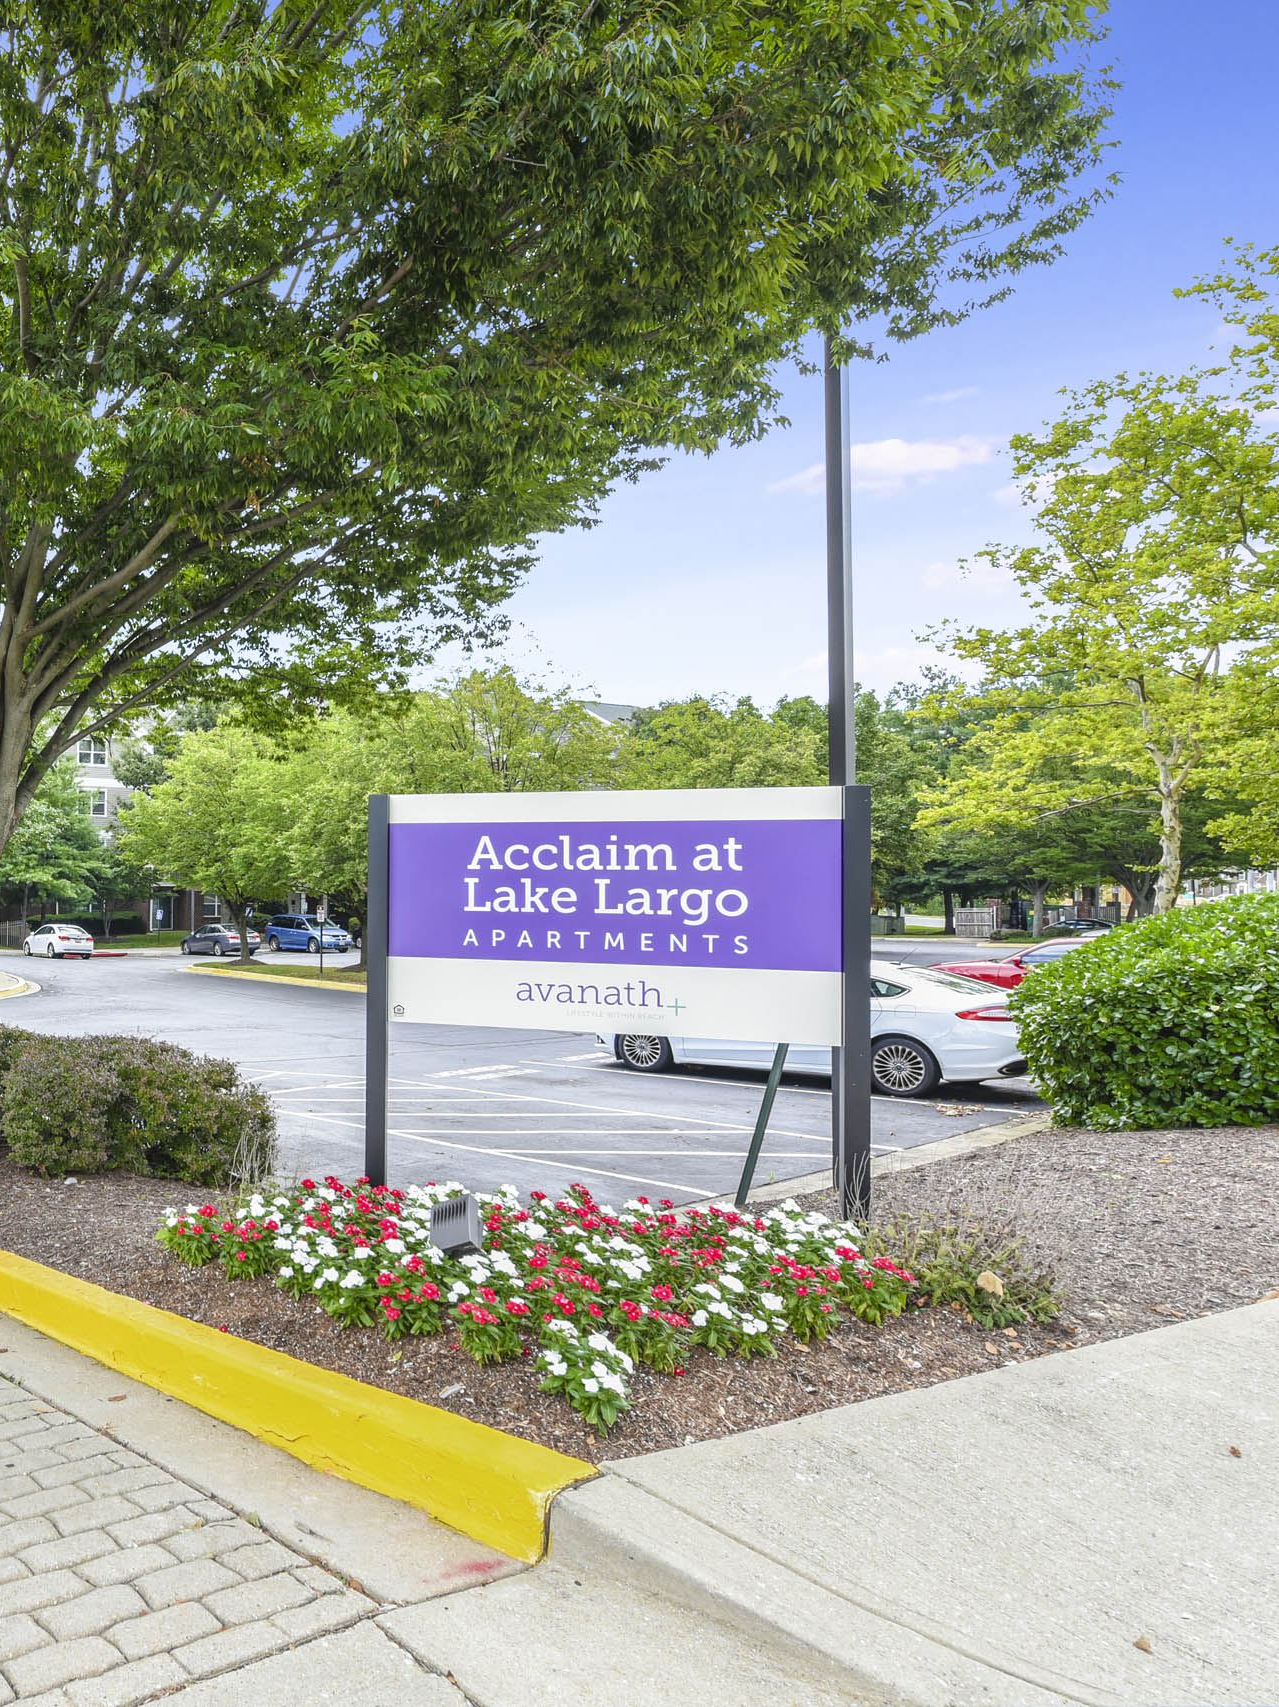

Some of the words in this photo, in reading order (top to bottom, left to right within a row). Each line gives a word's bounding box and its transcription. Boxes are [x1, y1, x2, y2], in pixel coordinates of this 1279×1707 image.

[466, 834, 677, 871] Acclaim
[692, 836, 744, 872] at
[463, 877, 578, 914] Lake
[593, 878, 749, 926] Largo
[462, 928, 749, 955] APARTMENTS
[516, 980, 664, 1007] avanath
